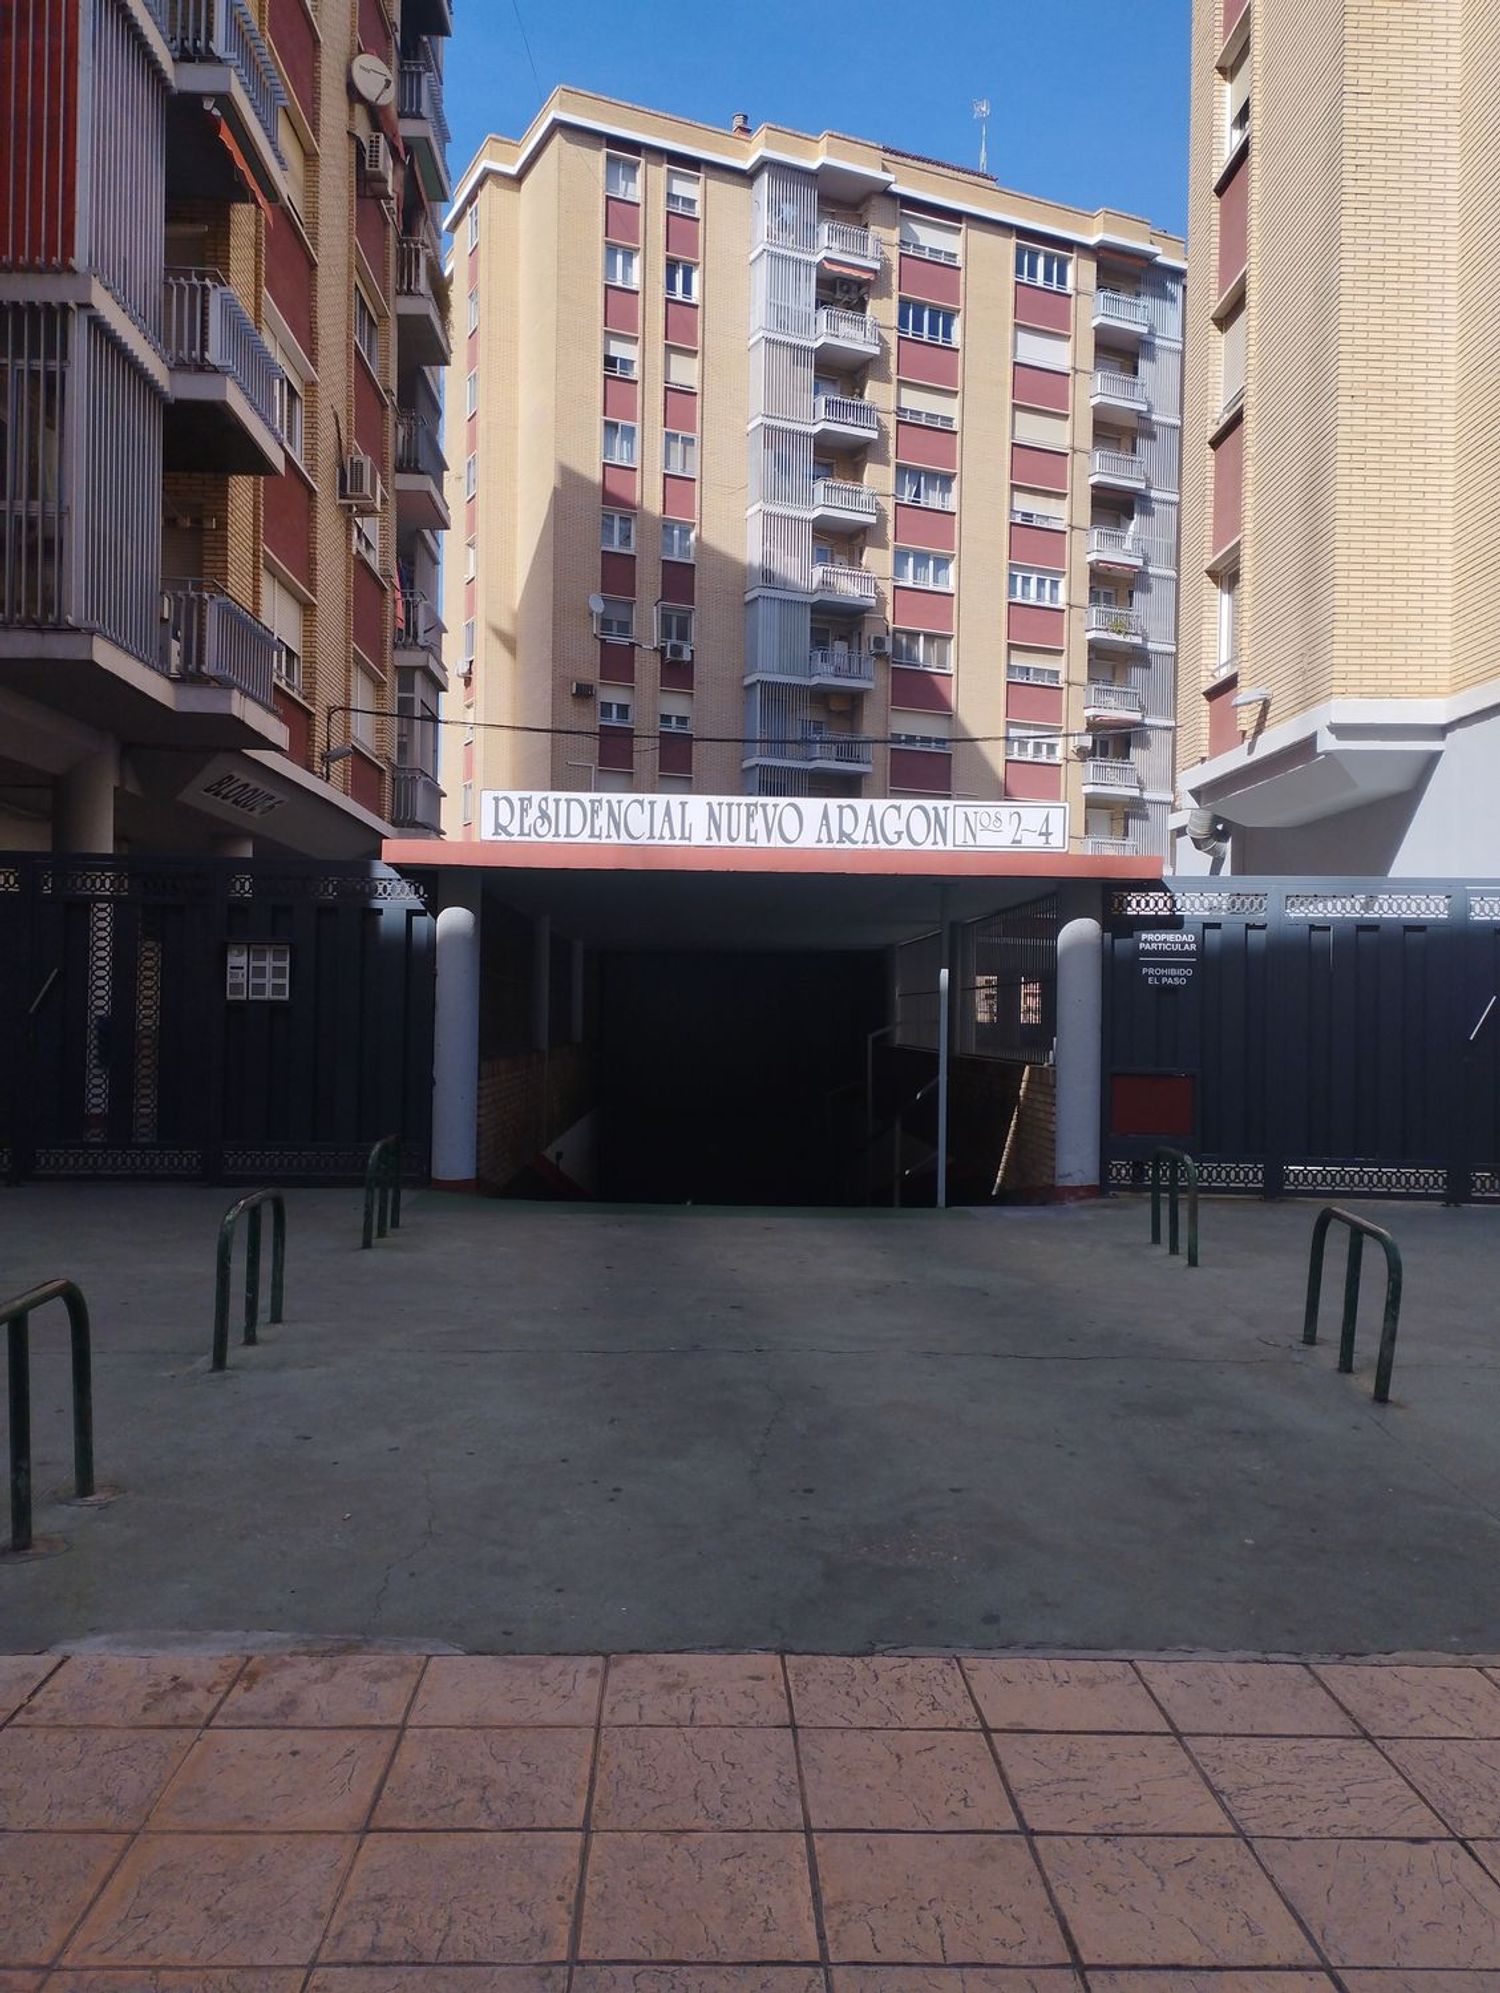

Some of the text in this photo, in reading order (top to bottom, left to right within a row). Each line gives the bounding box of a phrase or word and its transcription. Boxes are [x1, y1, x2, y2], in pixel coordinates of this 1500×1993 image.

[491, 795, 693, 843] RESIDENCIAL
[705, 800, 804, 845] NUEVO
[815, 802, 950, 847] ARAGON
[1008, 810, 1054, 845] 2-4
[1141, 933, 1195, 942] PROPIEDAD
[1139, 942, 1197, 951] PARTICULAR
[1142, 967, 1193, 977] PROHIBIDO
[1147, 977, 1187, 986] EL PASO
